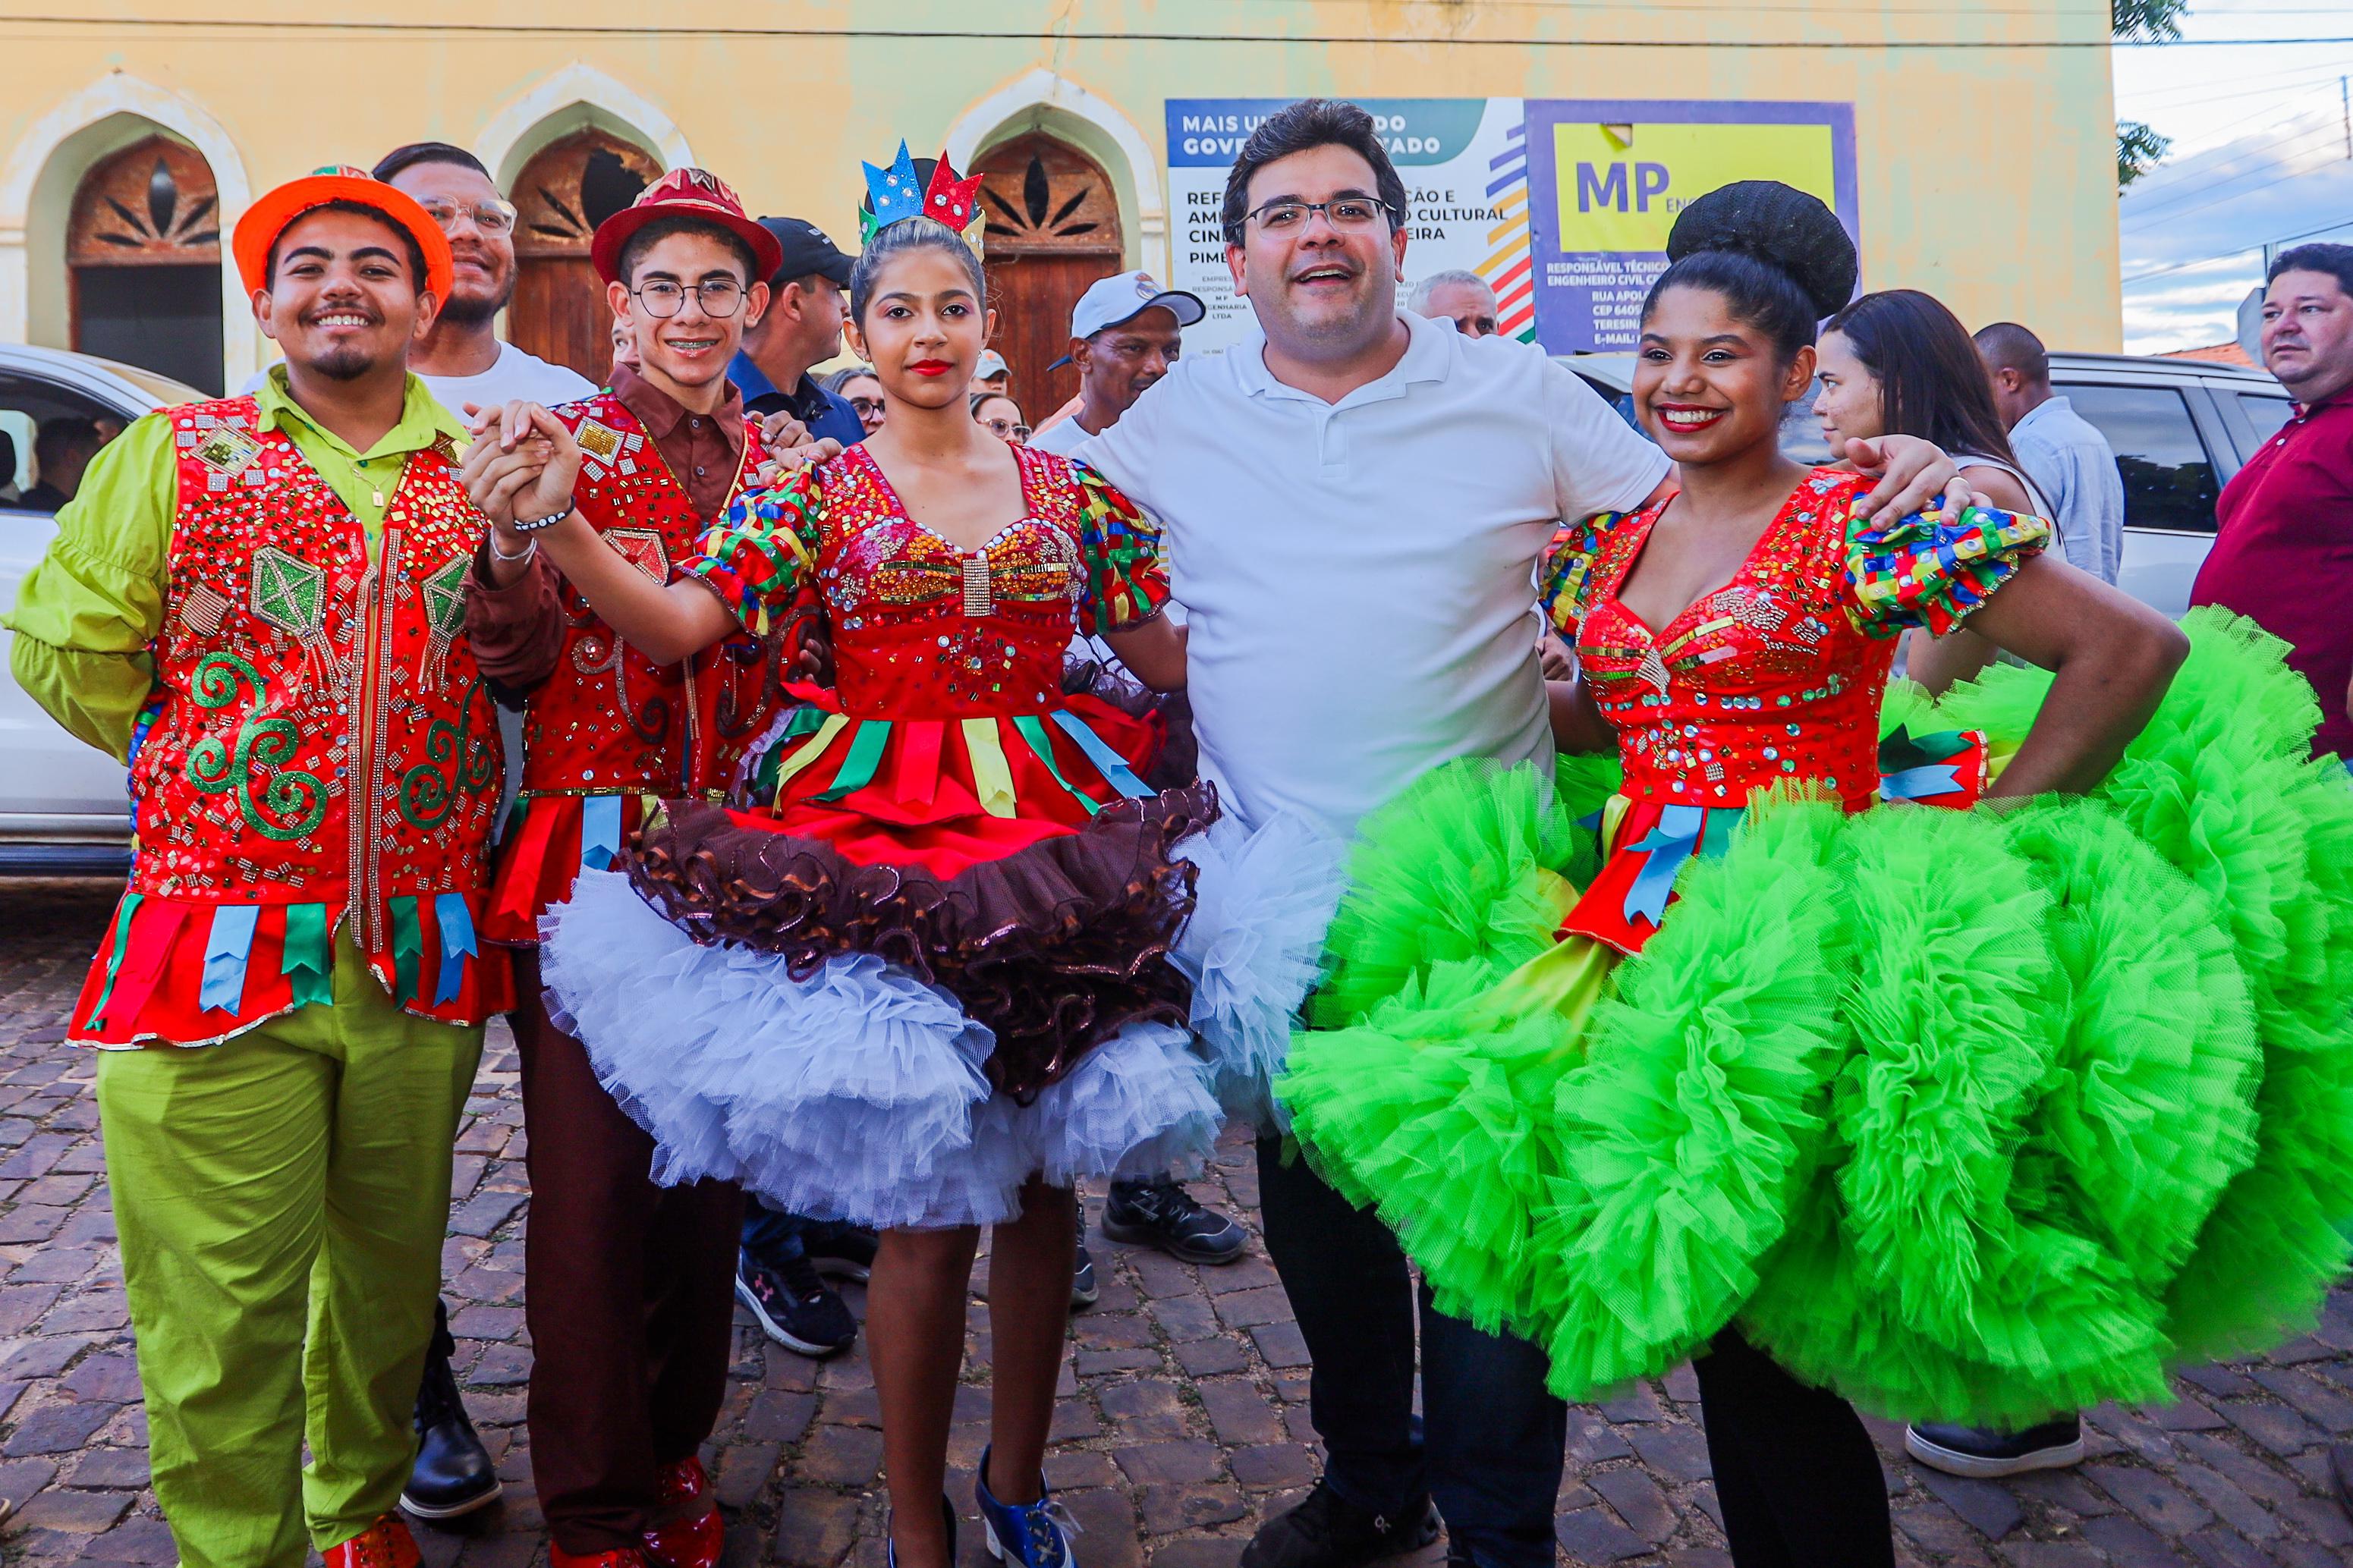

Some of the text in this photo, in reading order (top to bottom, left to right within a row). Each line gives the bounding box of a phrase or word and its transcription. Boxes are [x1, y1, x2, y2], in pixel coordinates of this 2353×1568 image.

[1183, 115, 1266, 133] MAIS U
[1184, 137, 1247, 156] GOVE
[1577, 162, 1669, 212] MP
[1188, 192, 1221, 205] REF
[1405, 187, 1455, 205] ÇÃO E
[1188, 212, 1222, 224] AM
[1417, 209, 1508, 222] CULTURAL
[1408, 228, 1445, 240] EIRA
[1190, 253, 1228, 263] PIME
[1546, 260, 1623, 274] RESPONSÁVEL
[1548, 274, 1617, 286] ENGENHEIRO
[1618, 274, 1645, 286] CIVIL
[1592, 291, 1615, 302] RUA
[1593, 305, 1613, 316] CEP
